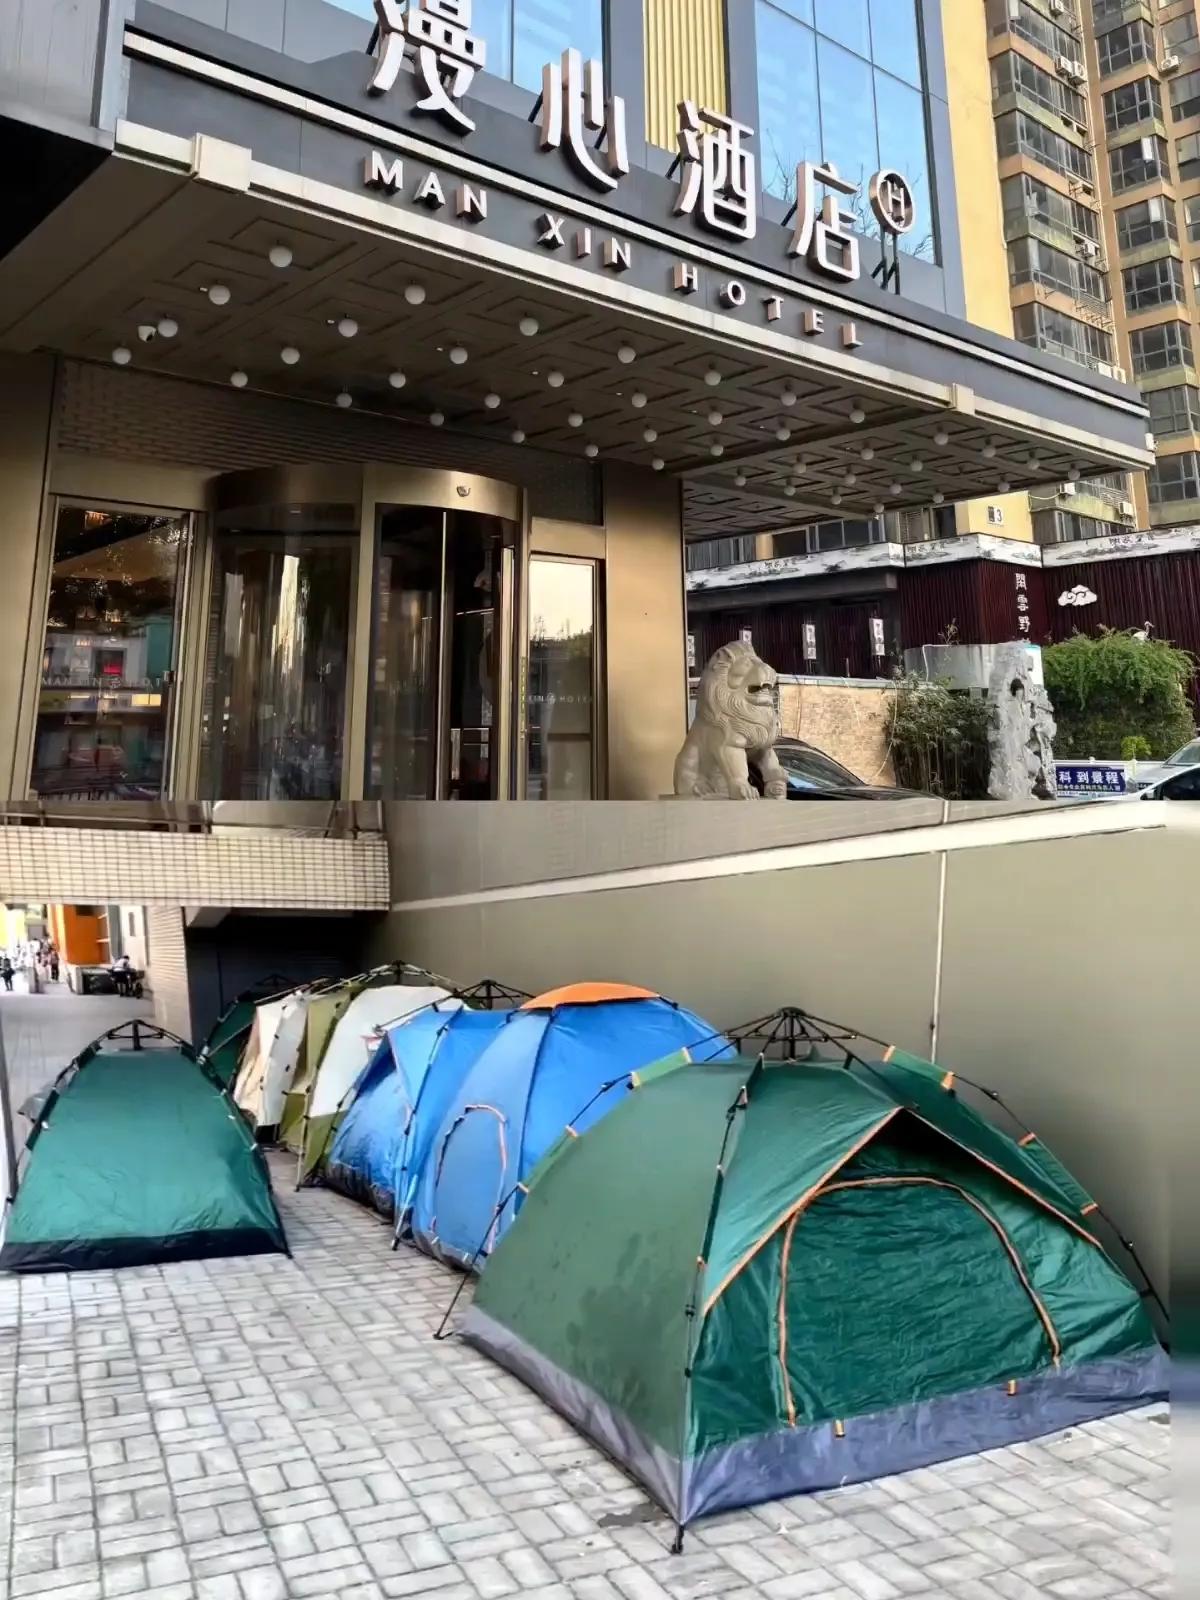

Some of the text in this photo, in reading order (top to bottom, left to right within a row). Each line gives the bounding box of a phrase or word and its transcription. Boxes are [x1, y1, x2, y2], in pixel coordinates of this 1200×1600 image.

[363, 150, 864, 348] MAN XIN HOTEL
[367, 0, 861, 282] 漫心酒店
